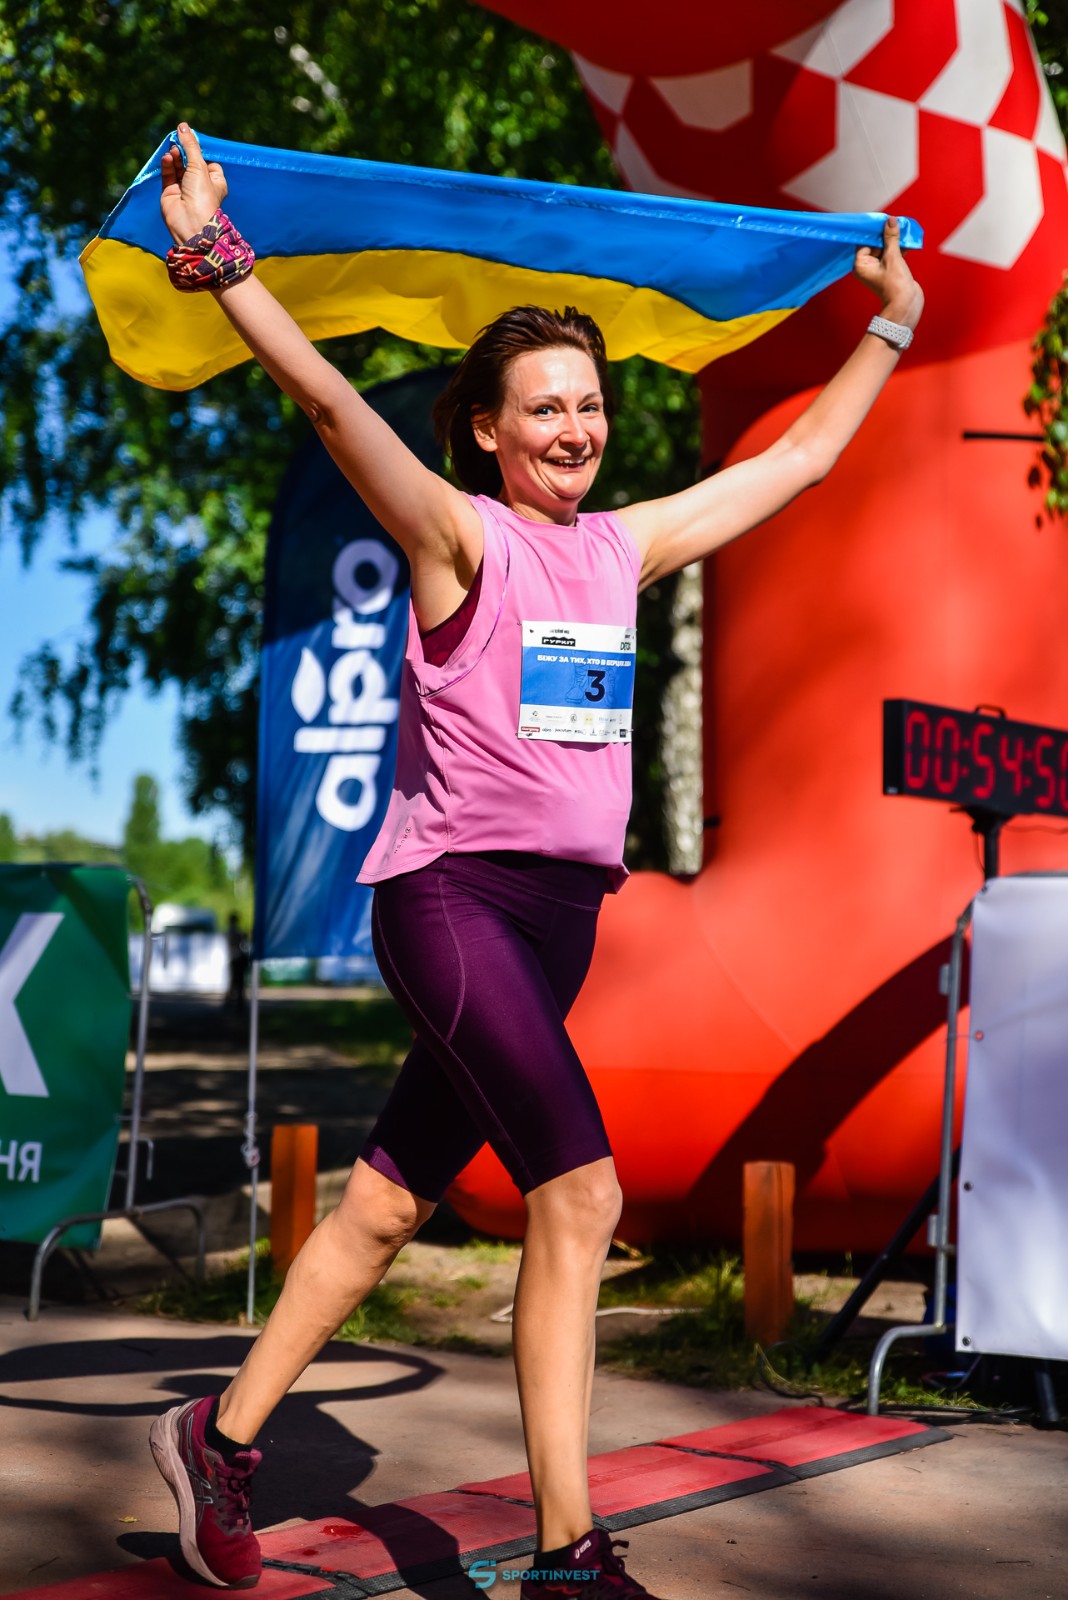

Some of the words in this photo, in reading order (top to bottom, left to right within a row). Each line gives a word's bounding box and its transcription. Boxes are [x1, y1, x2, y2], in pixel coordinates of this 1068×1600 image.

[537, 654, 557, 662] БІЖУ
[558, 655, 569, 663] ЗА
[570, 656, 586, 665] ТИХ,
[587, 658, 599, 666] ХТО
[293, 538, 399, 832] alpro
[584, 669, 606, 702] 3
